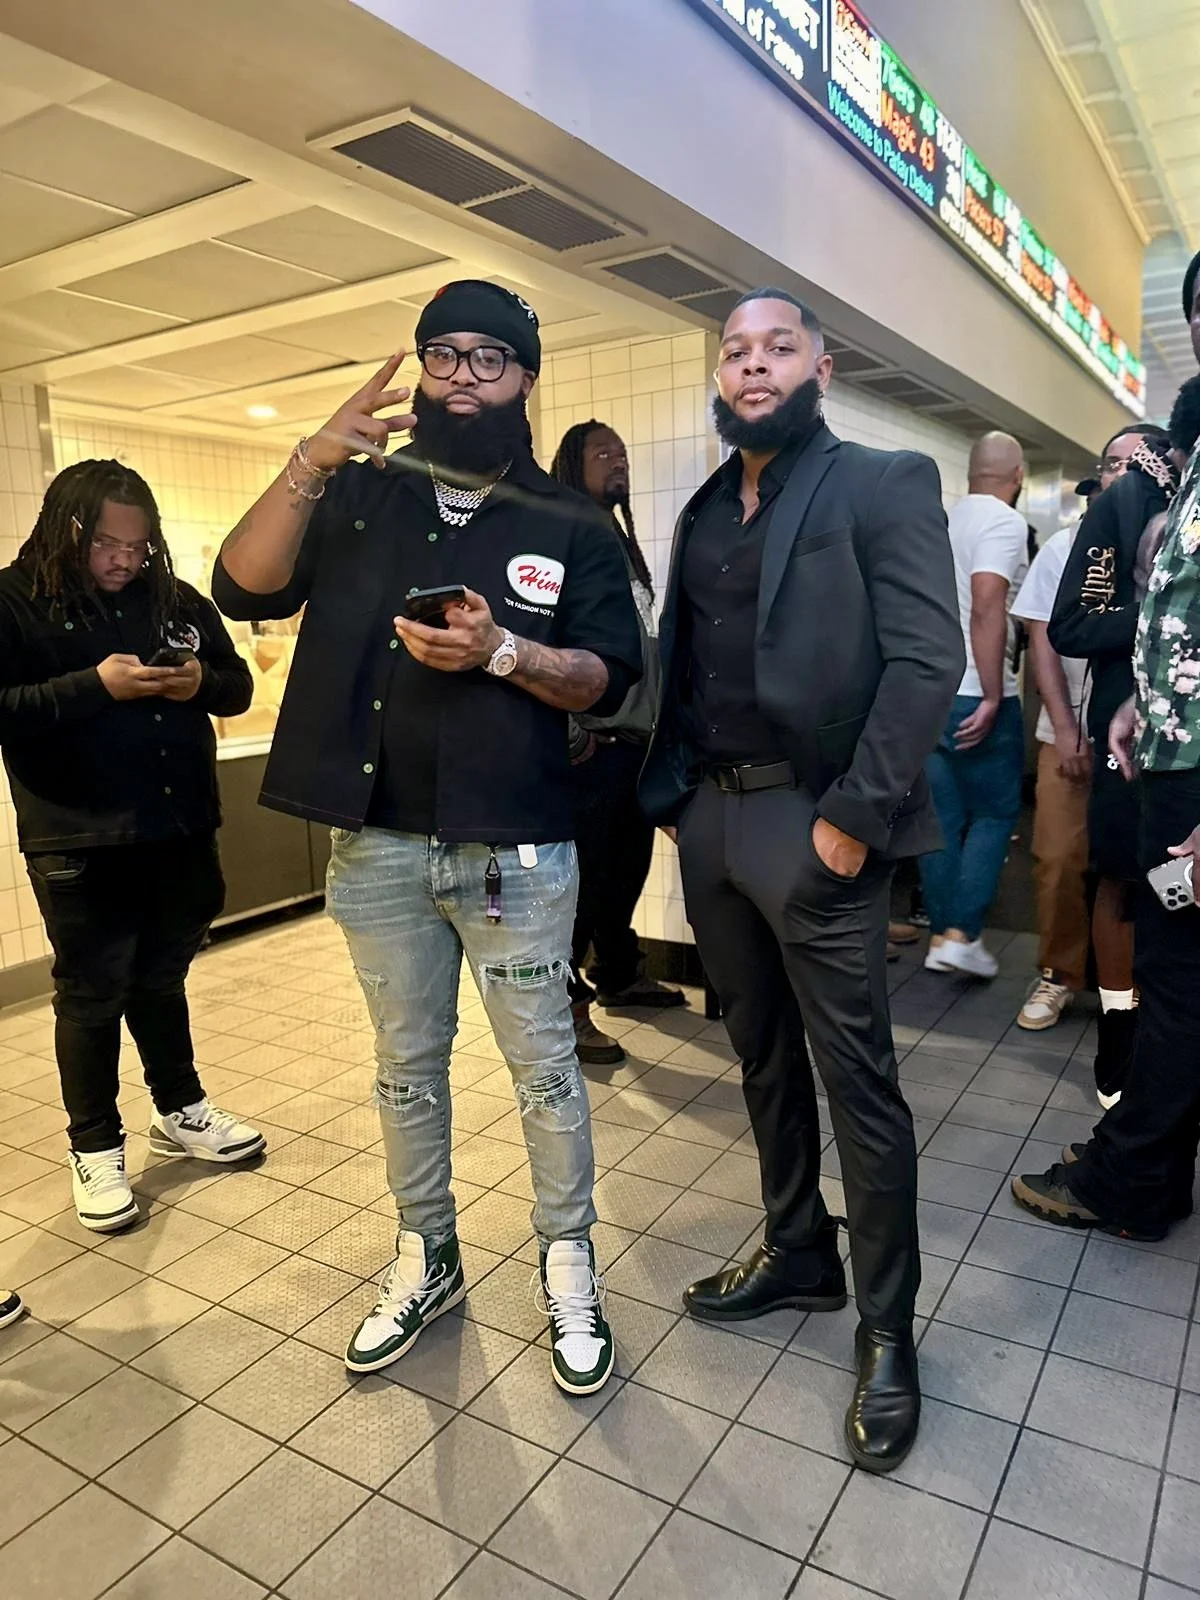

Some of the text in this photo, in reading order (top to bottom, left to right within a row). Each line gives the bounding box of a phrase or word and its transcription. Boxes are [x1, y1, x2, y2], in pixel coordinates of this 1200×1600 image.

[828, 81, 873, 147] Welcome
[873, 129, 883, 157] to
[881, 90, 916, 153] Magic
[514, 601, 539, 613] FASHION
